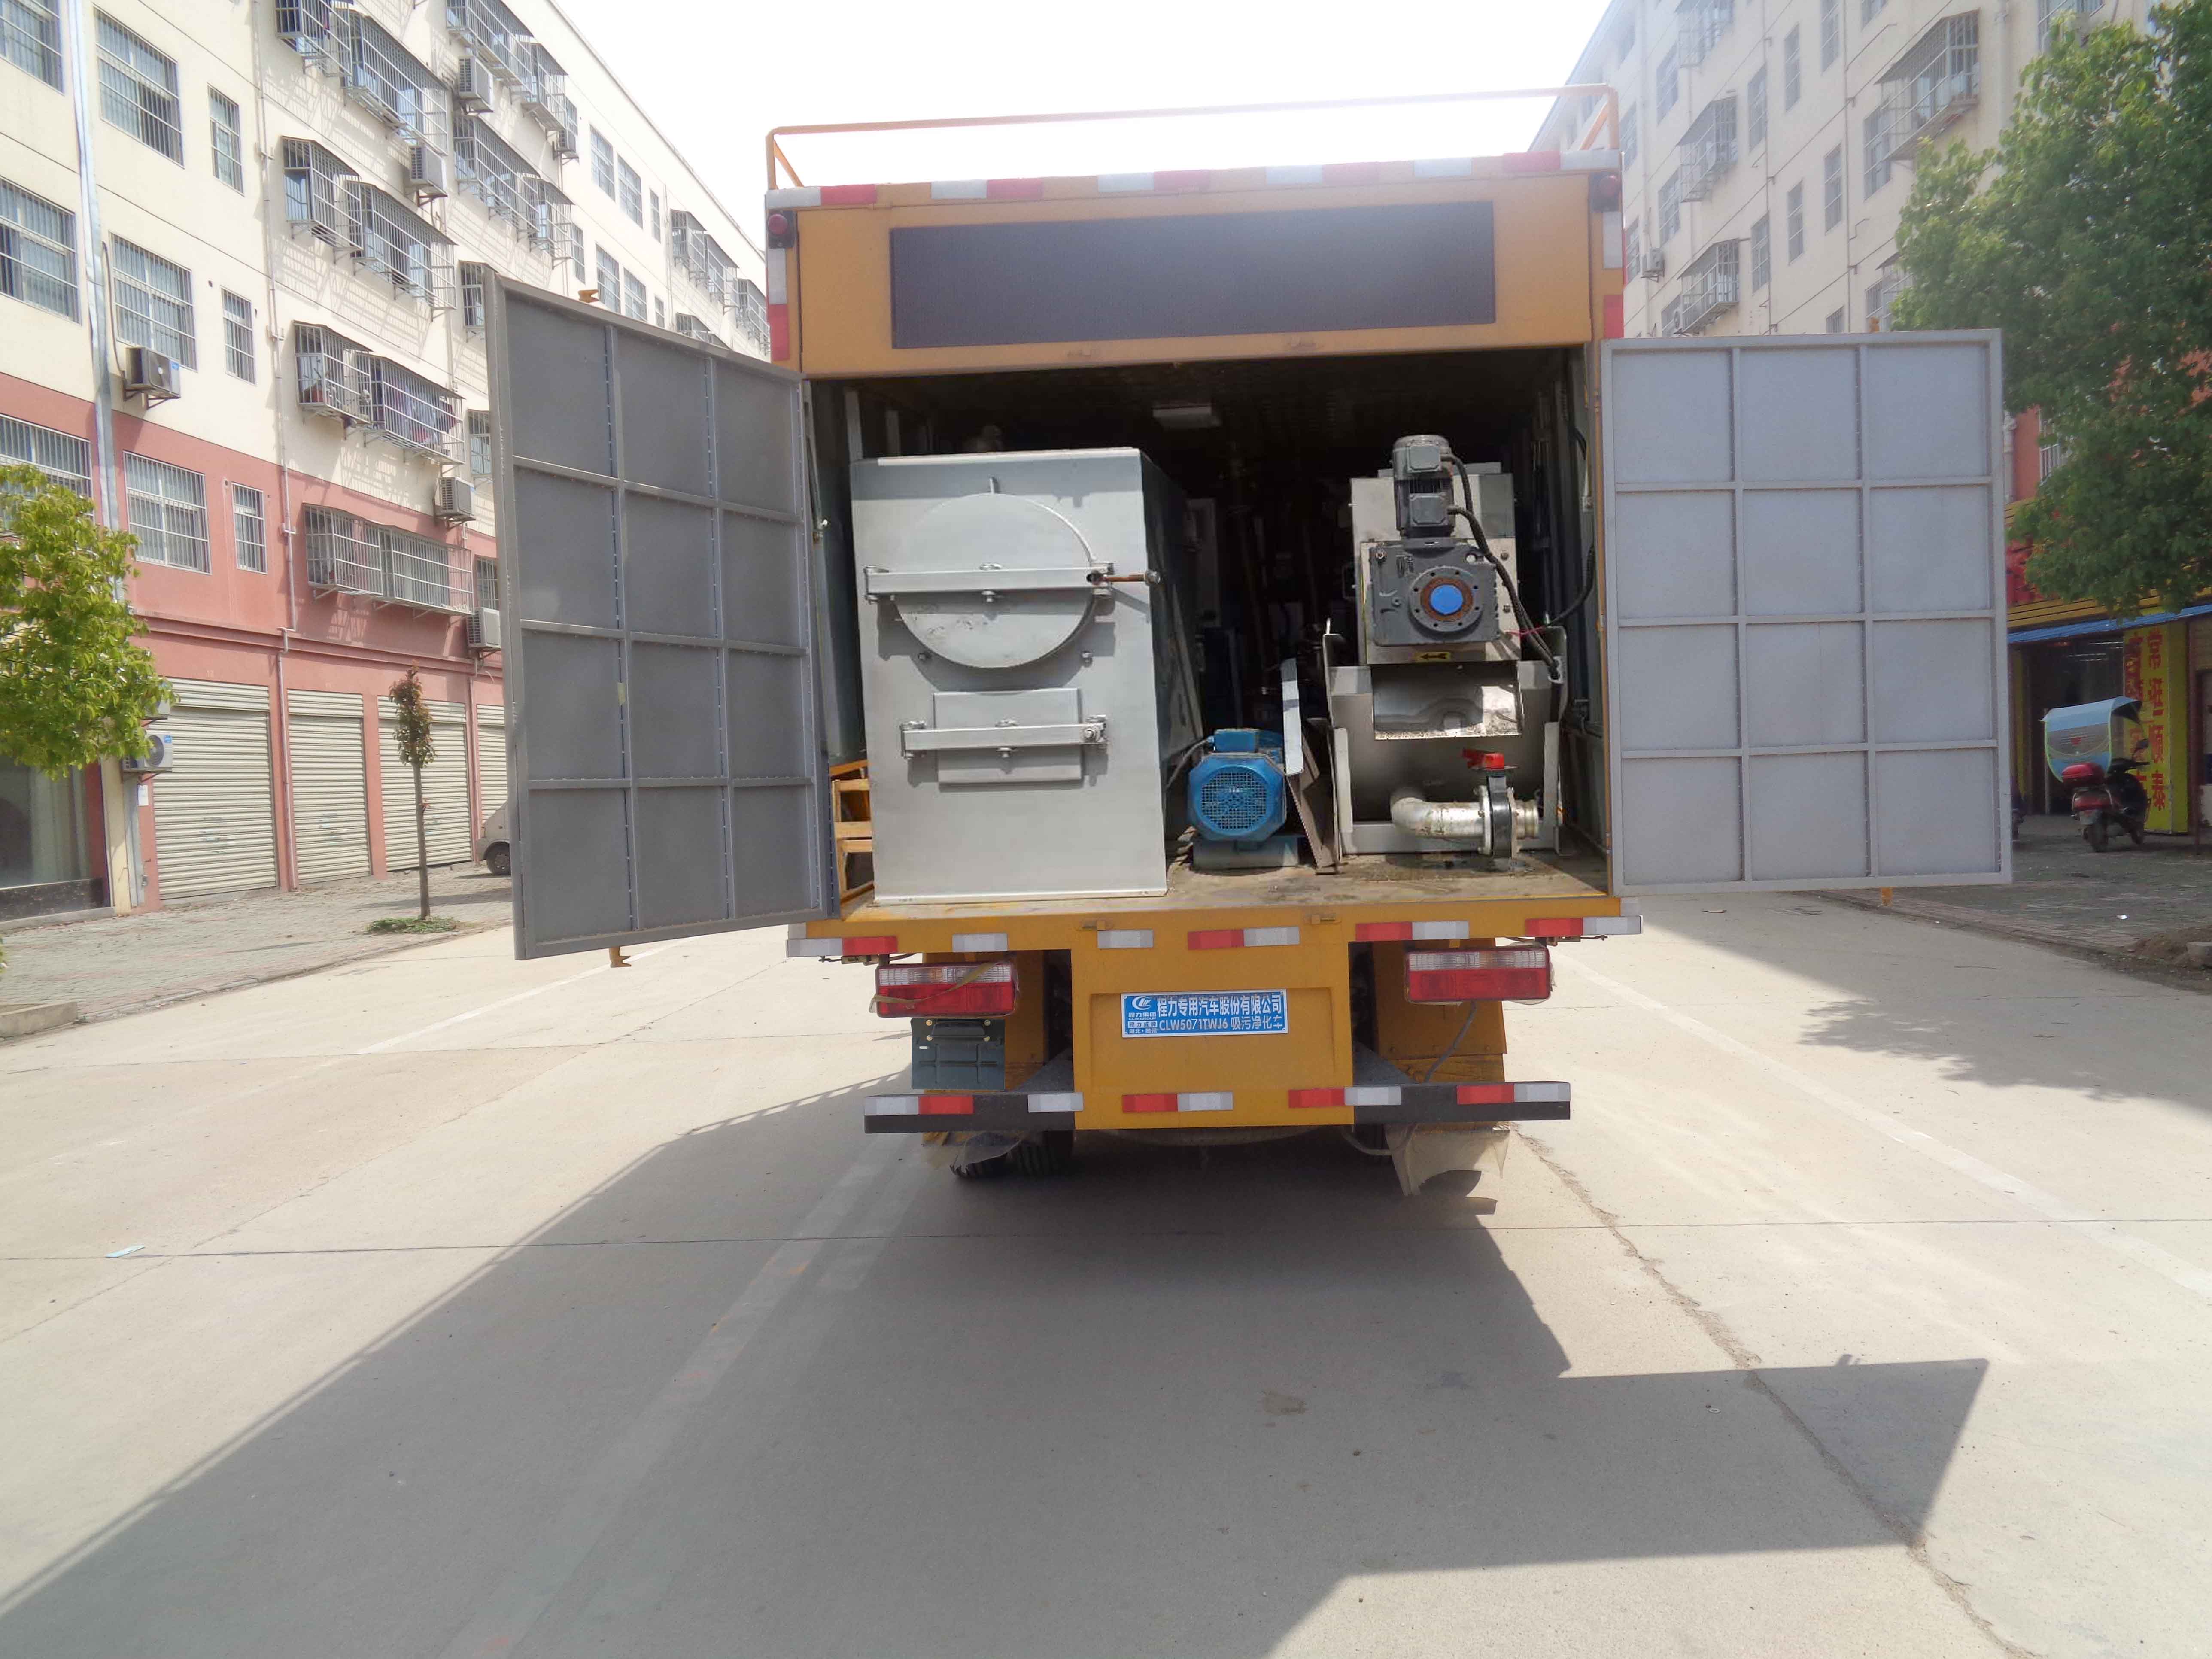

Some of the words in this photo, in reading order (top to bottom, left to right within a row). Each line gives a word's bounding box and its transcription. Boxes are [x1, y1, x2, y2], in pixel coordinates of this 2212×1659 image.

[1157, 995, 1282, 1017] 程力专用汽车股份有限公司
